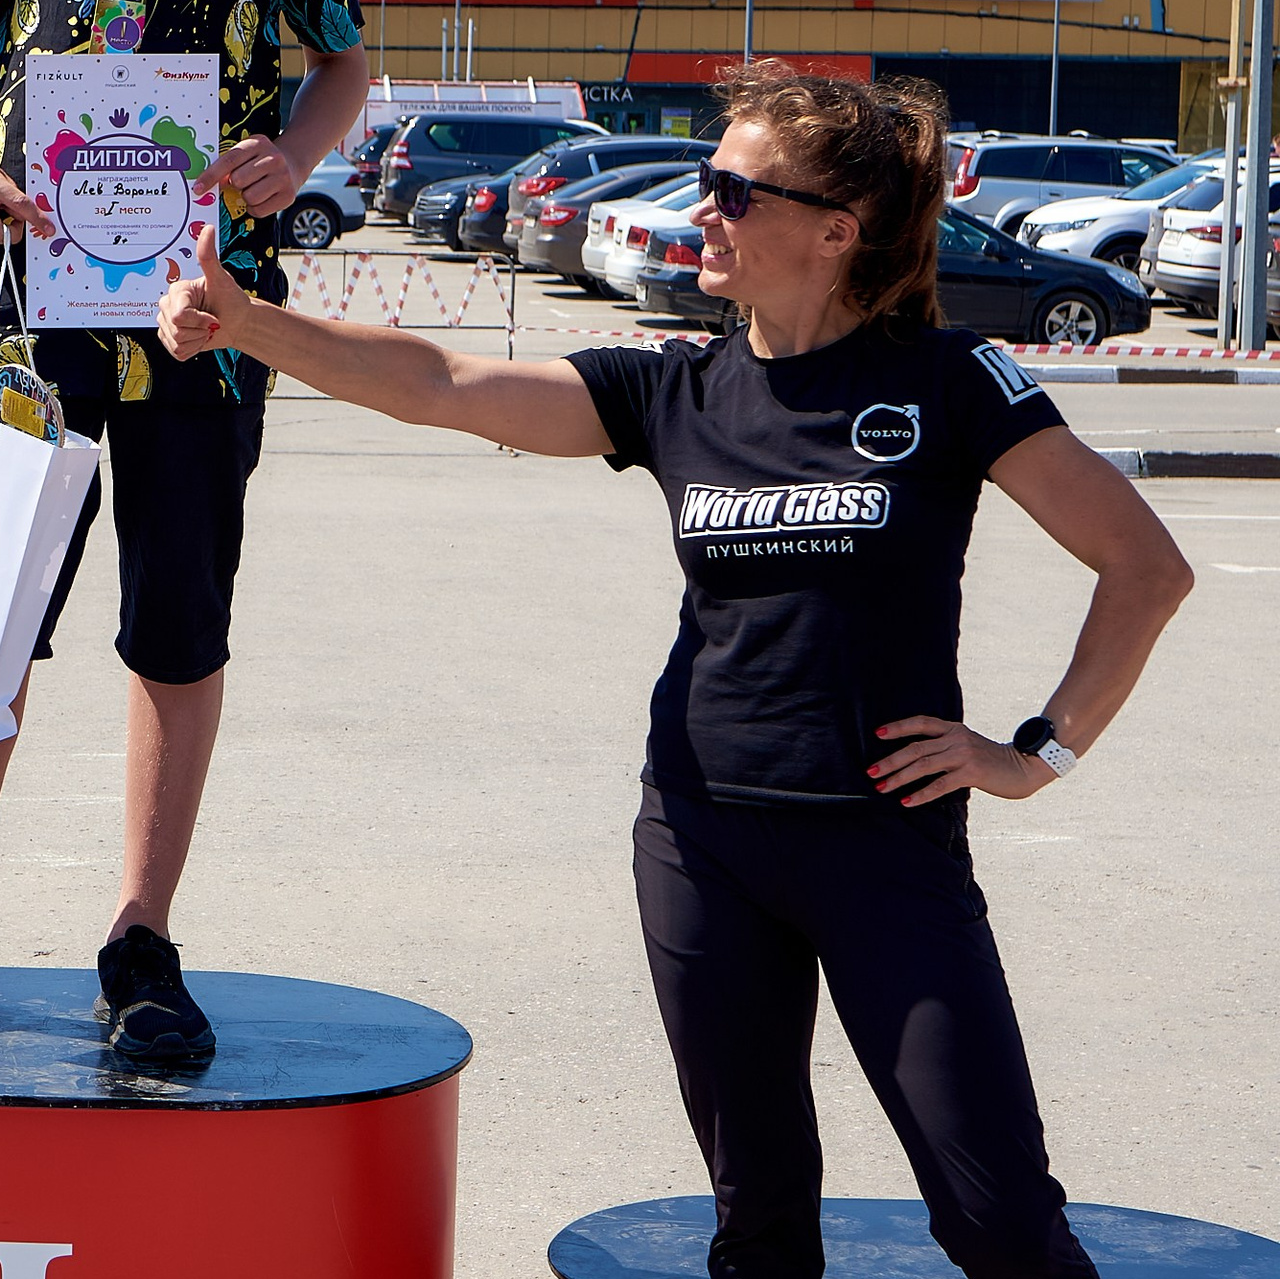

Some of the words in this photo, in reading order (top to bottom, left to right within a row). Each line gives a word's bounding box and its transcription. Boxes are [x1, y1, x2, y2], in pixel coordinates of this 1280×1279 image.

[36, 72, 84, 81] FIZKULT
[74, 149, 171, 170] ДИПЛОМ
[74, 180, 104, 196] Лев
[113, 180, 168, 198] Воронов
[120, 206, 152, 215] место
[67, 300, 99, 308] Желаем
[100, 300, 147, 309] дальнейших
[126, 309, 154, 317] побед!
[860, 430, 912, 438] VOLVO
[683, 490, 785, 530] World
[783, 488, 882, 524] Class
[706, 536, 854, 559] ПУШКИНСКИЙ
